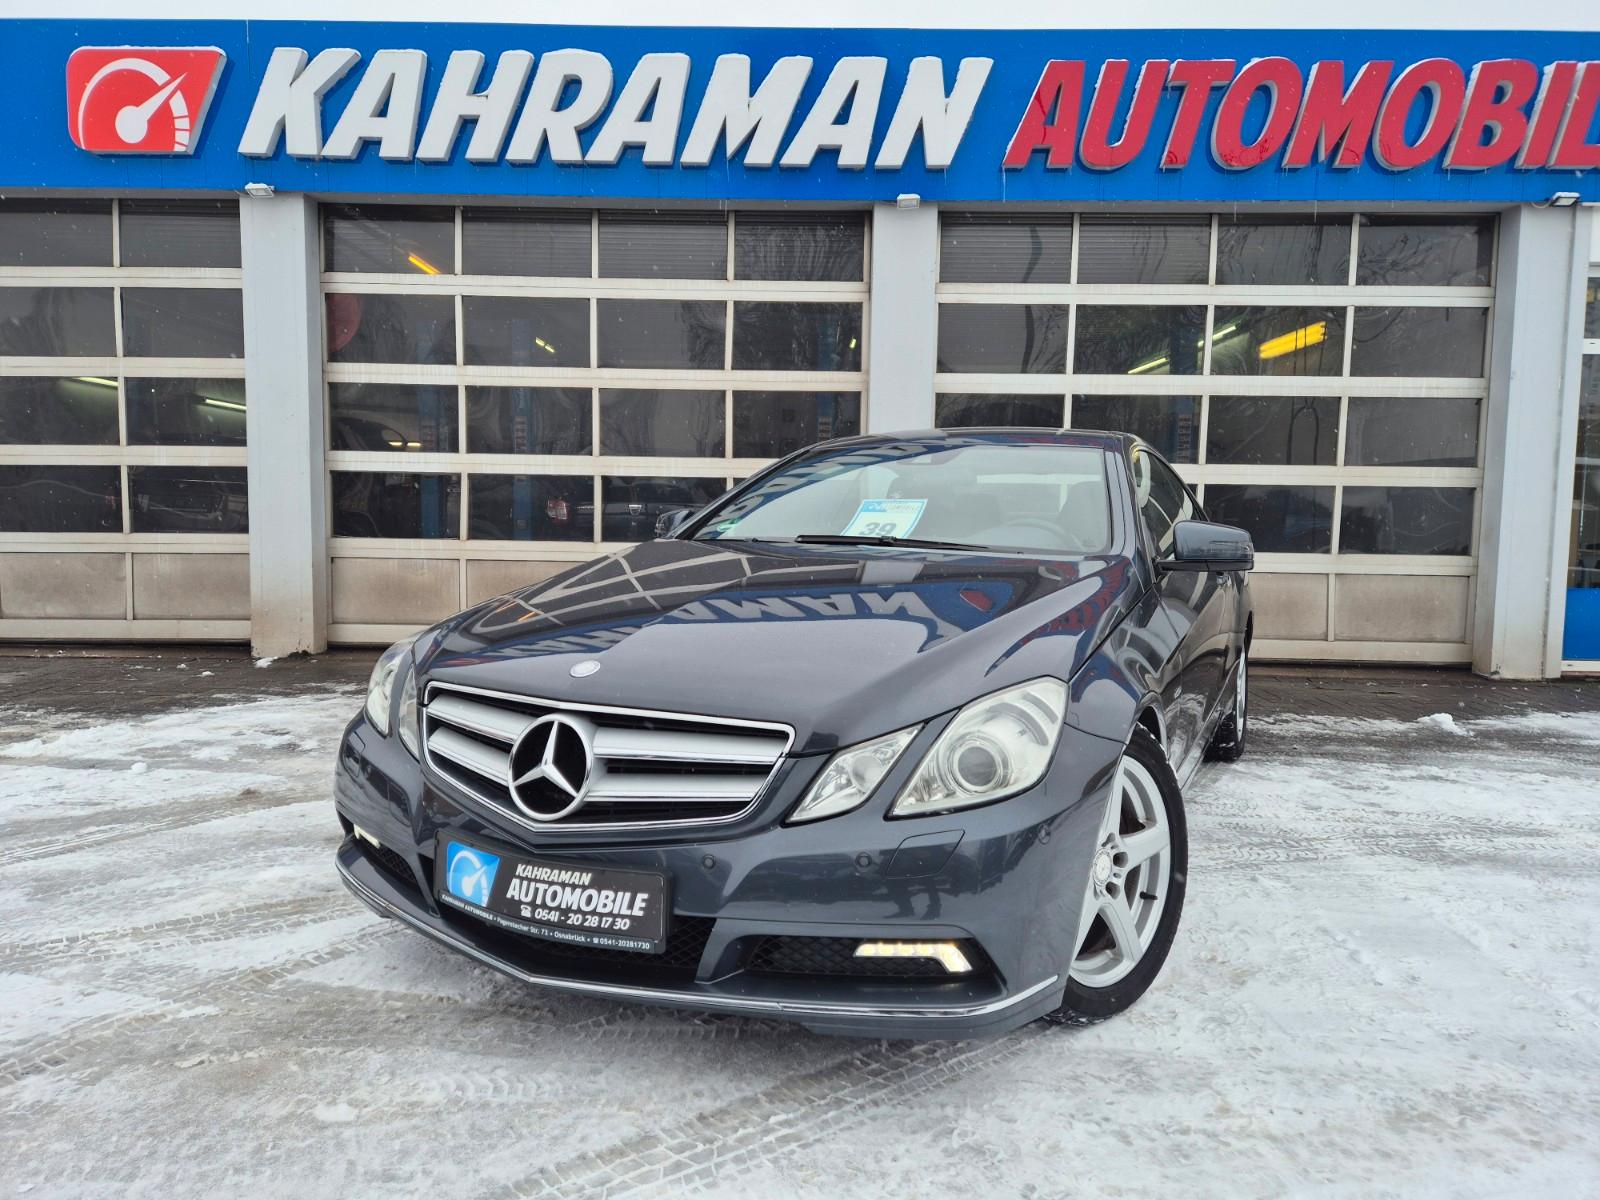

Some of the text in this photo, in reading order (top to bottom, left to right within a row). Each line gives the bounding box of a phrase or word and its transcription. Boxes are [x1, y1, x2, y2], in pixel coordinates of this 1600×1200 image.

[238, 46, 994, 170] KAHRAMAN
[859, 522, 897, 536] 39
[515, 863, 592, 886] KAHRAMAN
[506, 878, 649, 916] AUTOMOBILE
[534, 908, 559, 923] 0541
[566, 913, 582, 926] 20
[583, 915, 599, 927] 28
[601, 917, 613, 929] 17
[613, 918, 630, 930] 30
[554, 931, 586, 942] Osnabrück
